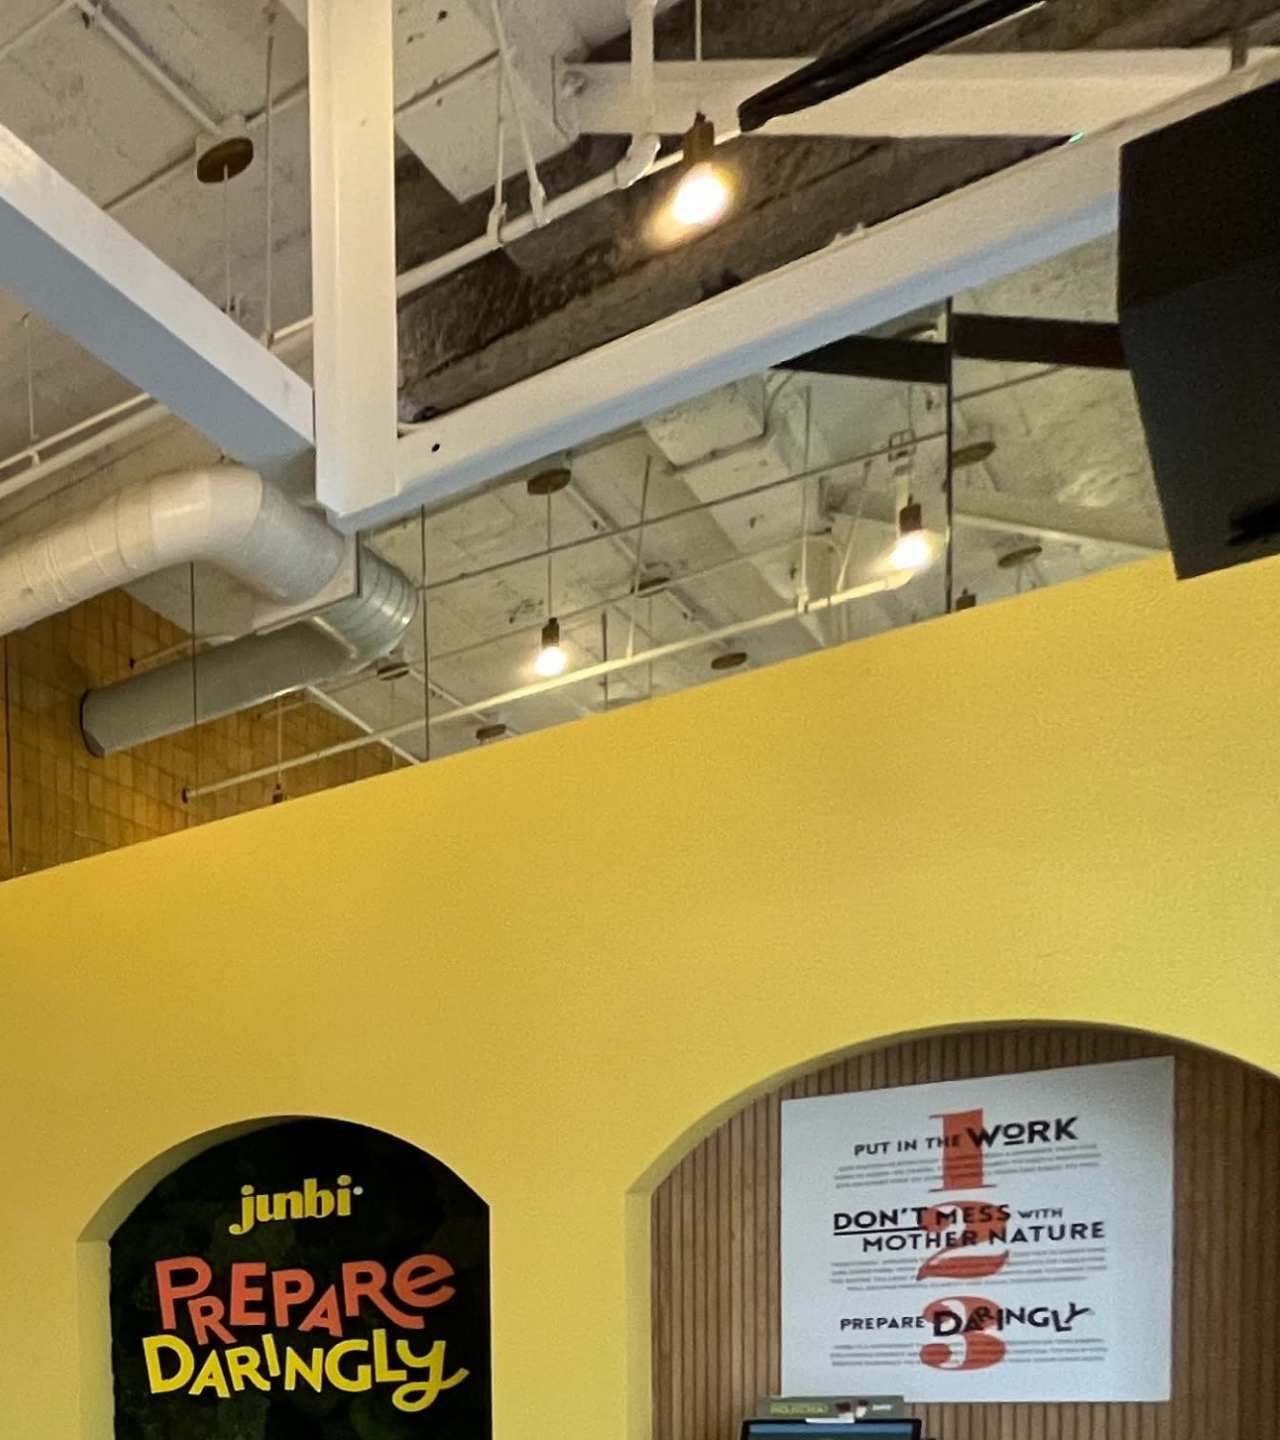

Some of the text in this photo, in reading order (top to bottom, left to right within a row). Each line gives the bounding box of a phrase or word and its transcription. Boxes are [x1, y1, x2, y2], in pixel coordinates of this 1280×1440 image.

[854, 1116, 1079, 1156] PUT IN THE WORK
[228, 1174, 353, 1235] junbi
[833, 1204, 1064, 1233] DON'T MESS WITH
[863, 1221, 1106, 1252] MOTHER NATURE
[840, 1301, 1091, 1338] PREPARE DARINGLY
